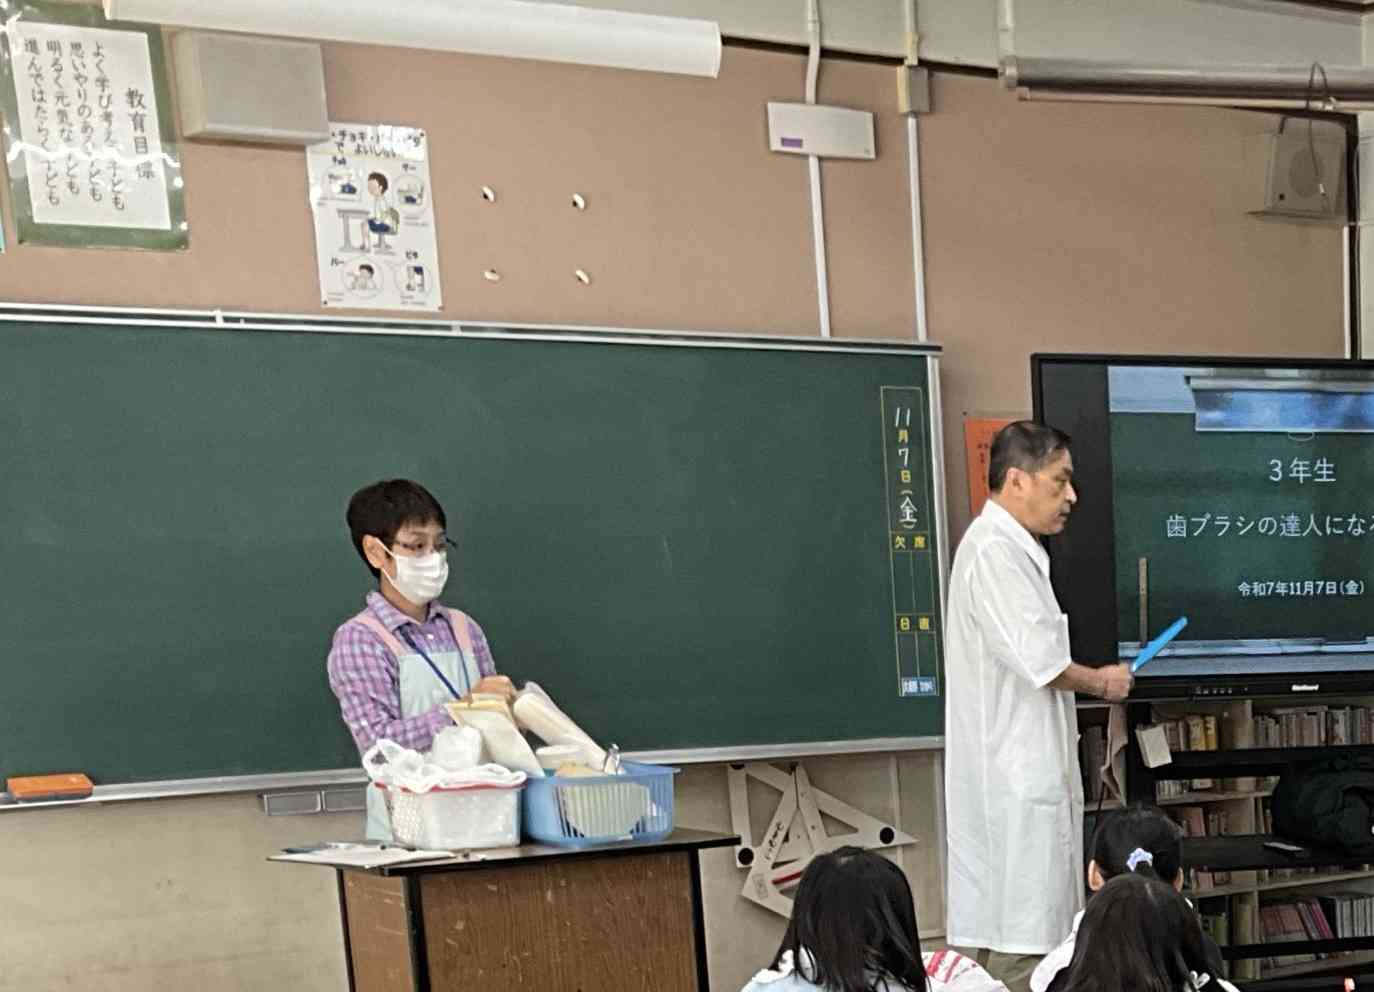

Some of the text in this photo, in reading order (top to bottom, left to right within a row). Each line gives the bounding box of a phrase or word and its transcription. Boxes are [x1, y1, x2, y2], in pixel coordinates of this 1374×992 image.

[1268, 457, 1337, 484] 3年生
[1238, 579, 1365, 597] 令和7年11月7日(金)
